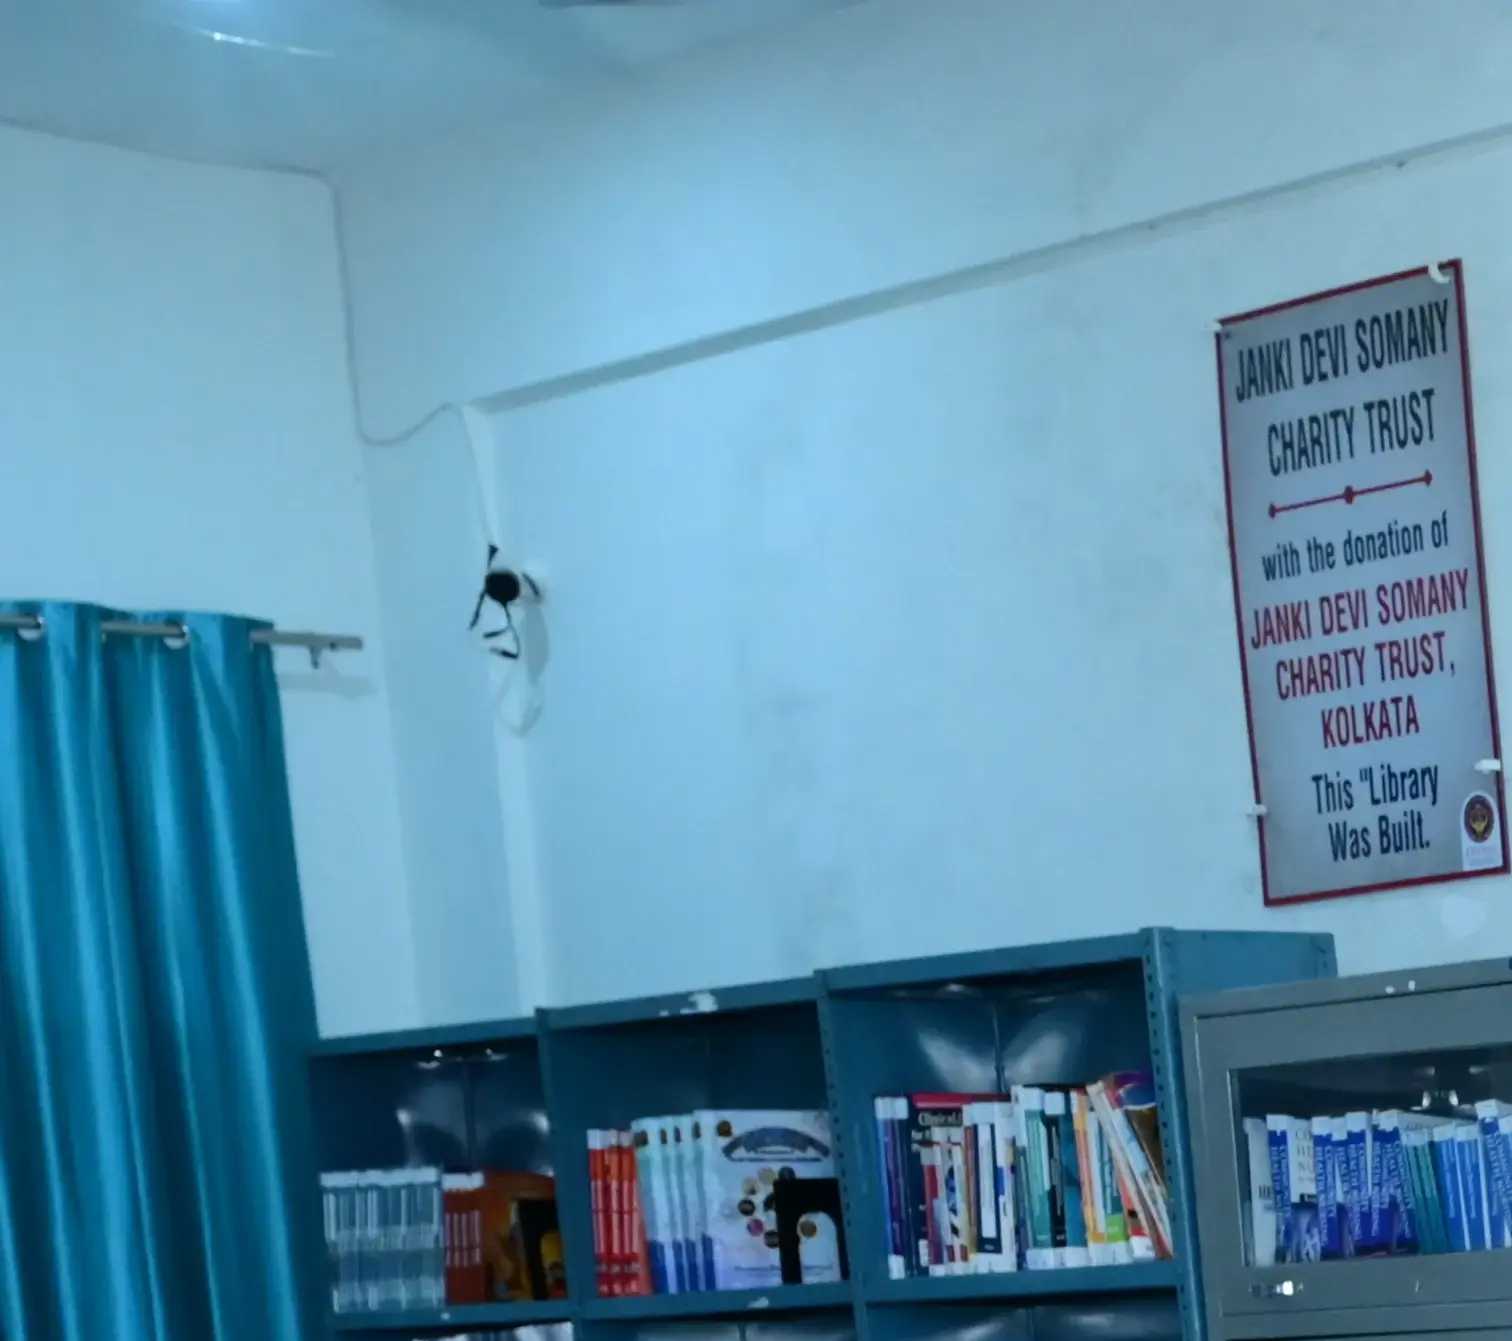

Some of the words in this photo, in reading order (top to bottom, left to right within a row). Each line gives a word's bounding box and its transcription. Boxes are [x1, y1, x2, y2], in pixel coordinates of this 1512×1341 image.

[1236, 337, 1294, 403] JANKI
[1300, 324, 1349, 386] DEVI
[1355, 298, 1449, 373] SOMANY
[1268, 406, 1355, 476] CHARITY
[1364, 388, 1435, 454] TRUST
[1262, 541, 1301, 581] with
[1307, 536, 1336, 573] the
[1343, 519, 1424, 566] donation
[1431, 510, 1449, 549] of
[1251, 599, 1312, 650] JANKI
[1319, 588, 1369, 635] DEVI
[1376, 568, 1469, 625] SOMANY
[1276, 645, 1365, 700] CHARITY
[1375, 631, 1456, 682] TRUST,
[1321, 695, 1420, 749] KOLKATA
[1312, 771, 1354, 814] This
[1328, 820, 1371, 862] Was
[1378, 810, 1430, 855] Built.
